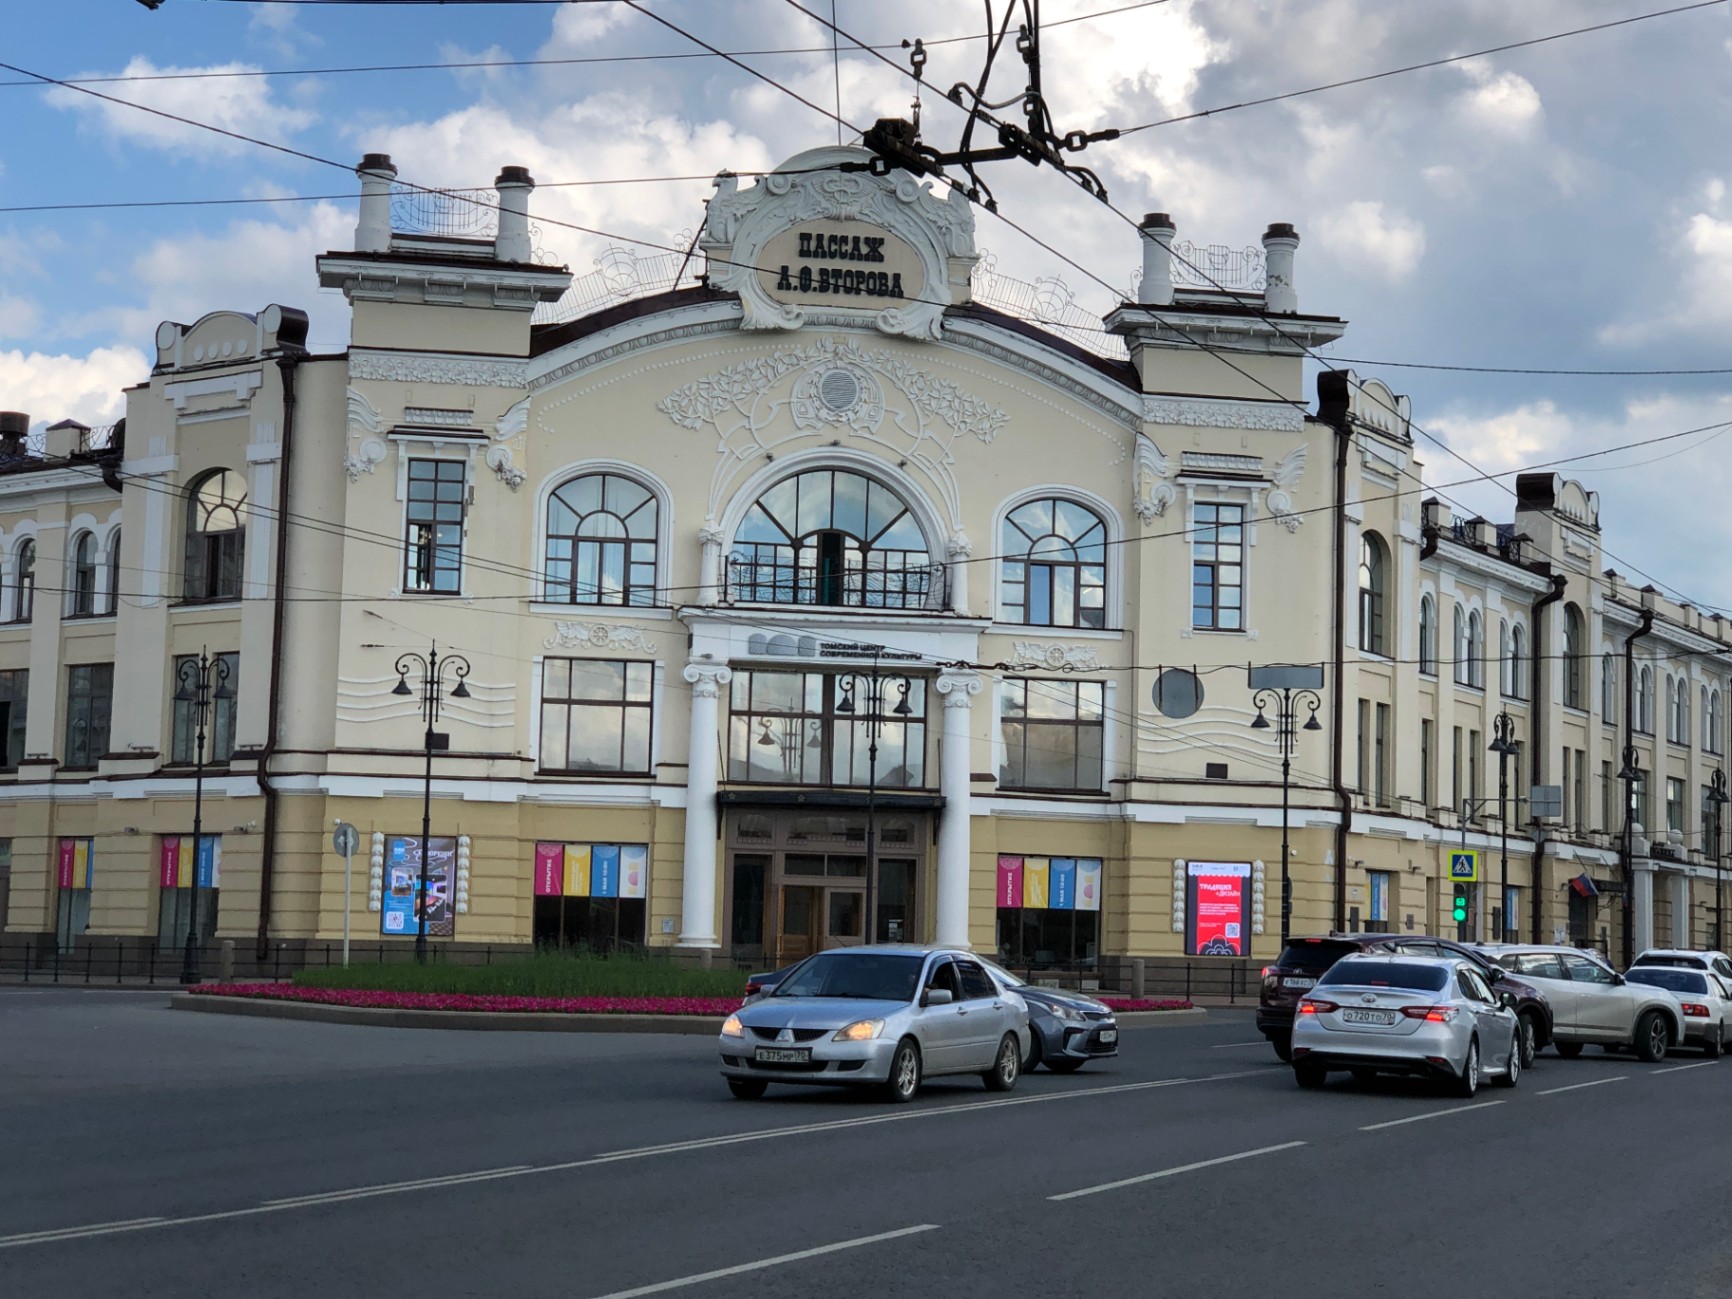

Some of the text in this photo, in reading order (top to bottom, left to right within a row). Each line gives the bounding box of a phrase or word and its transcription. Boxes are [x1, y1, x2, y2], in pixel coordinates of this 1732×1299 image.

[799, 233, 884, 262] ПАССАЖ
[860, 644, 885, 652] ЦЕНТР
[820, 650, 922, 660] СОВРЕМЕННОЙ КУЛЬТУРЫ
